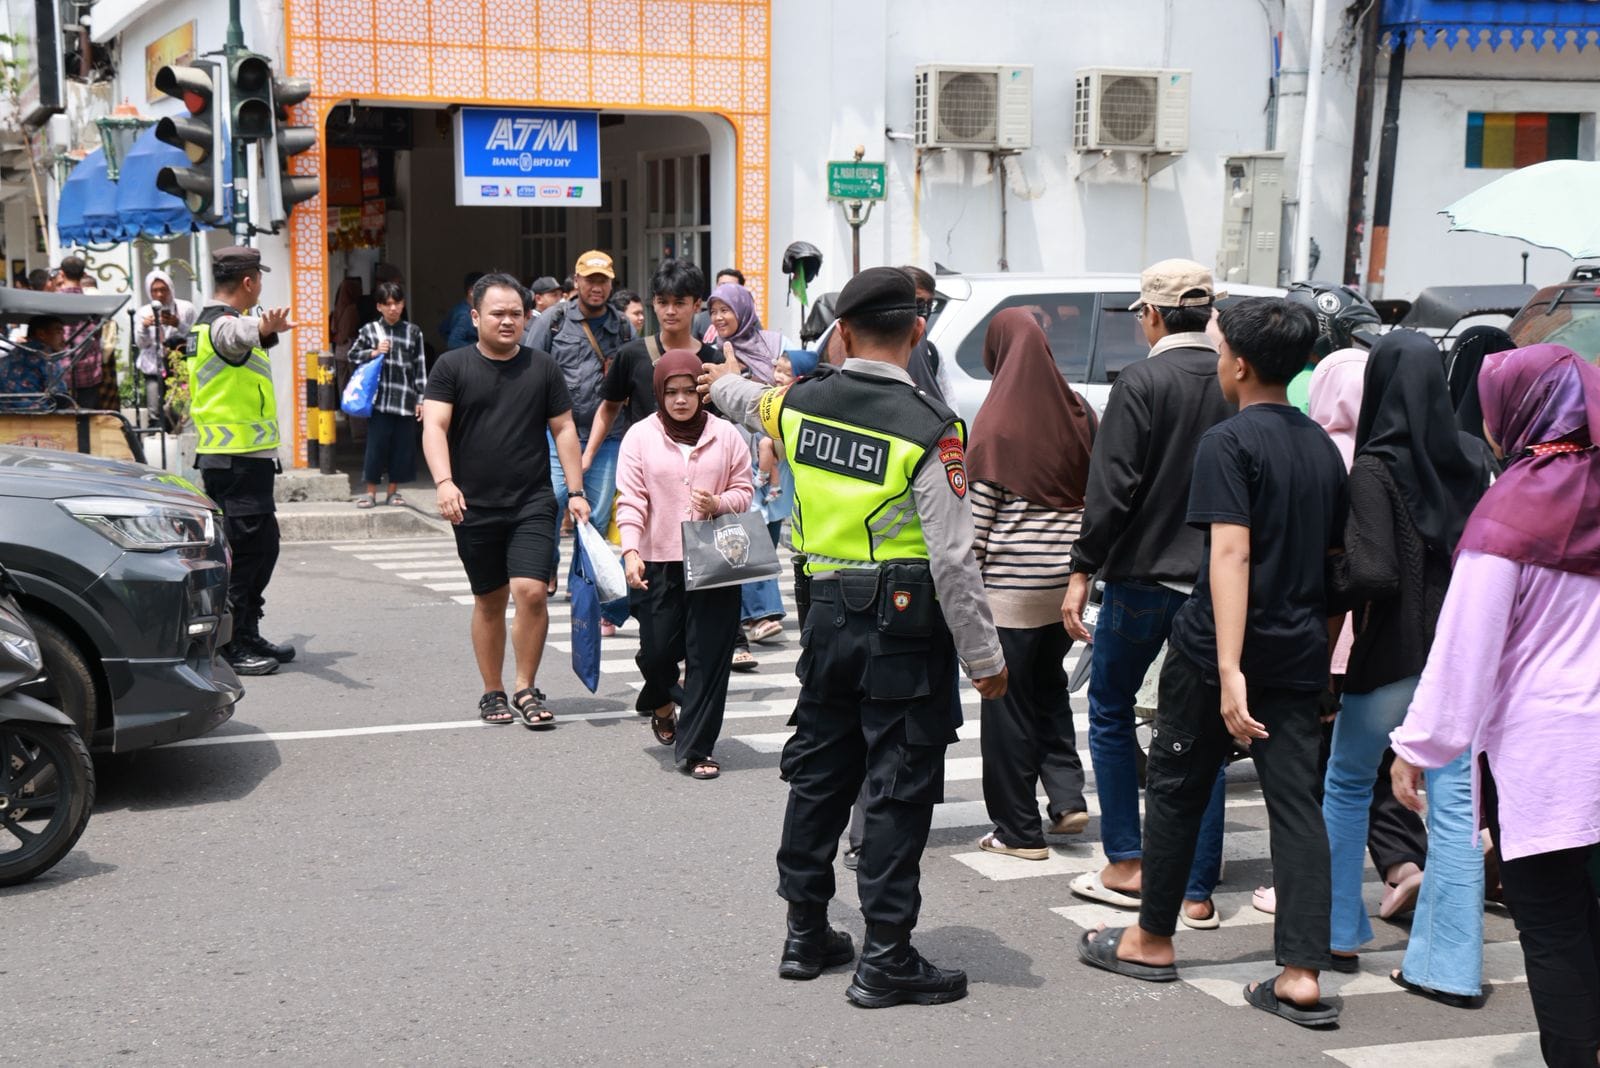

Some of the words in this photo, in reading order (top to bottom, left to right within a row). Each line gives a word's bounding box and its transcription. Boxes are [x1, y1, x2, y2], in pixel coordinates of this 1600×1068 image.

[486, 118, 577, 151] ATM
[492, 157, 519, 167] BANK
[533, 158, 553, 168] BPD
[554, 158, 572, 168] DIY
[799, 428, 882, 475] POLISI
